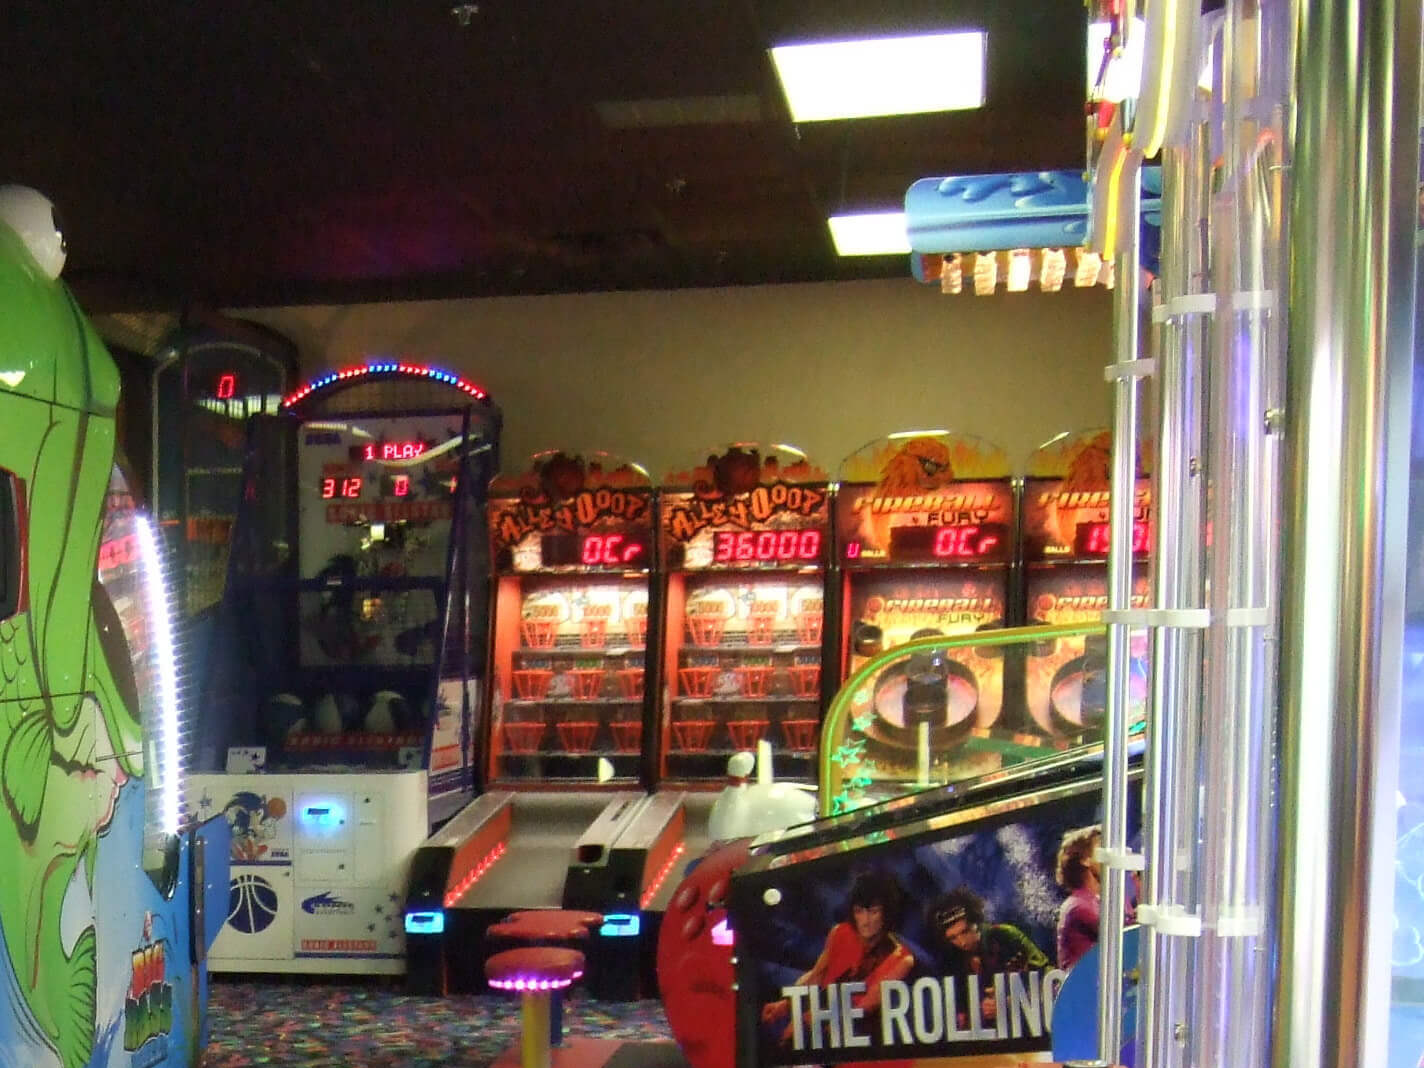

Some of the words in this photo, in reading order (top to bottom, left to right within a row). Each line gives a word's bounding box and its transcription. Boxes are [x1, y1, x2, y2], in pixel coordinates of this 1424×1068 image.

[383, 443, 424, 459] PLAY
[322, 478, 362, 498] 312
[501, 505, 574, 543] ALLEY
[671, 503, 752, 543] ALLEY
[927, 511, 990, 525] FURY
[715, 530, 821, 562] 36000
[781, 981, 871, 1050] THE
